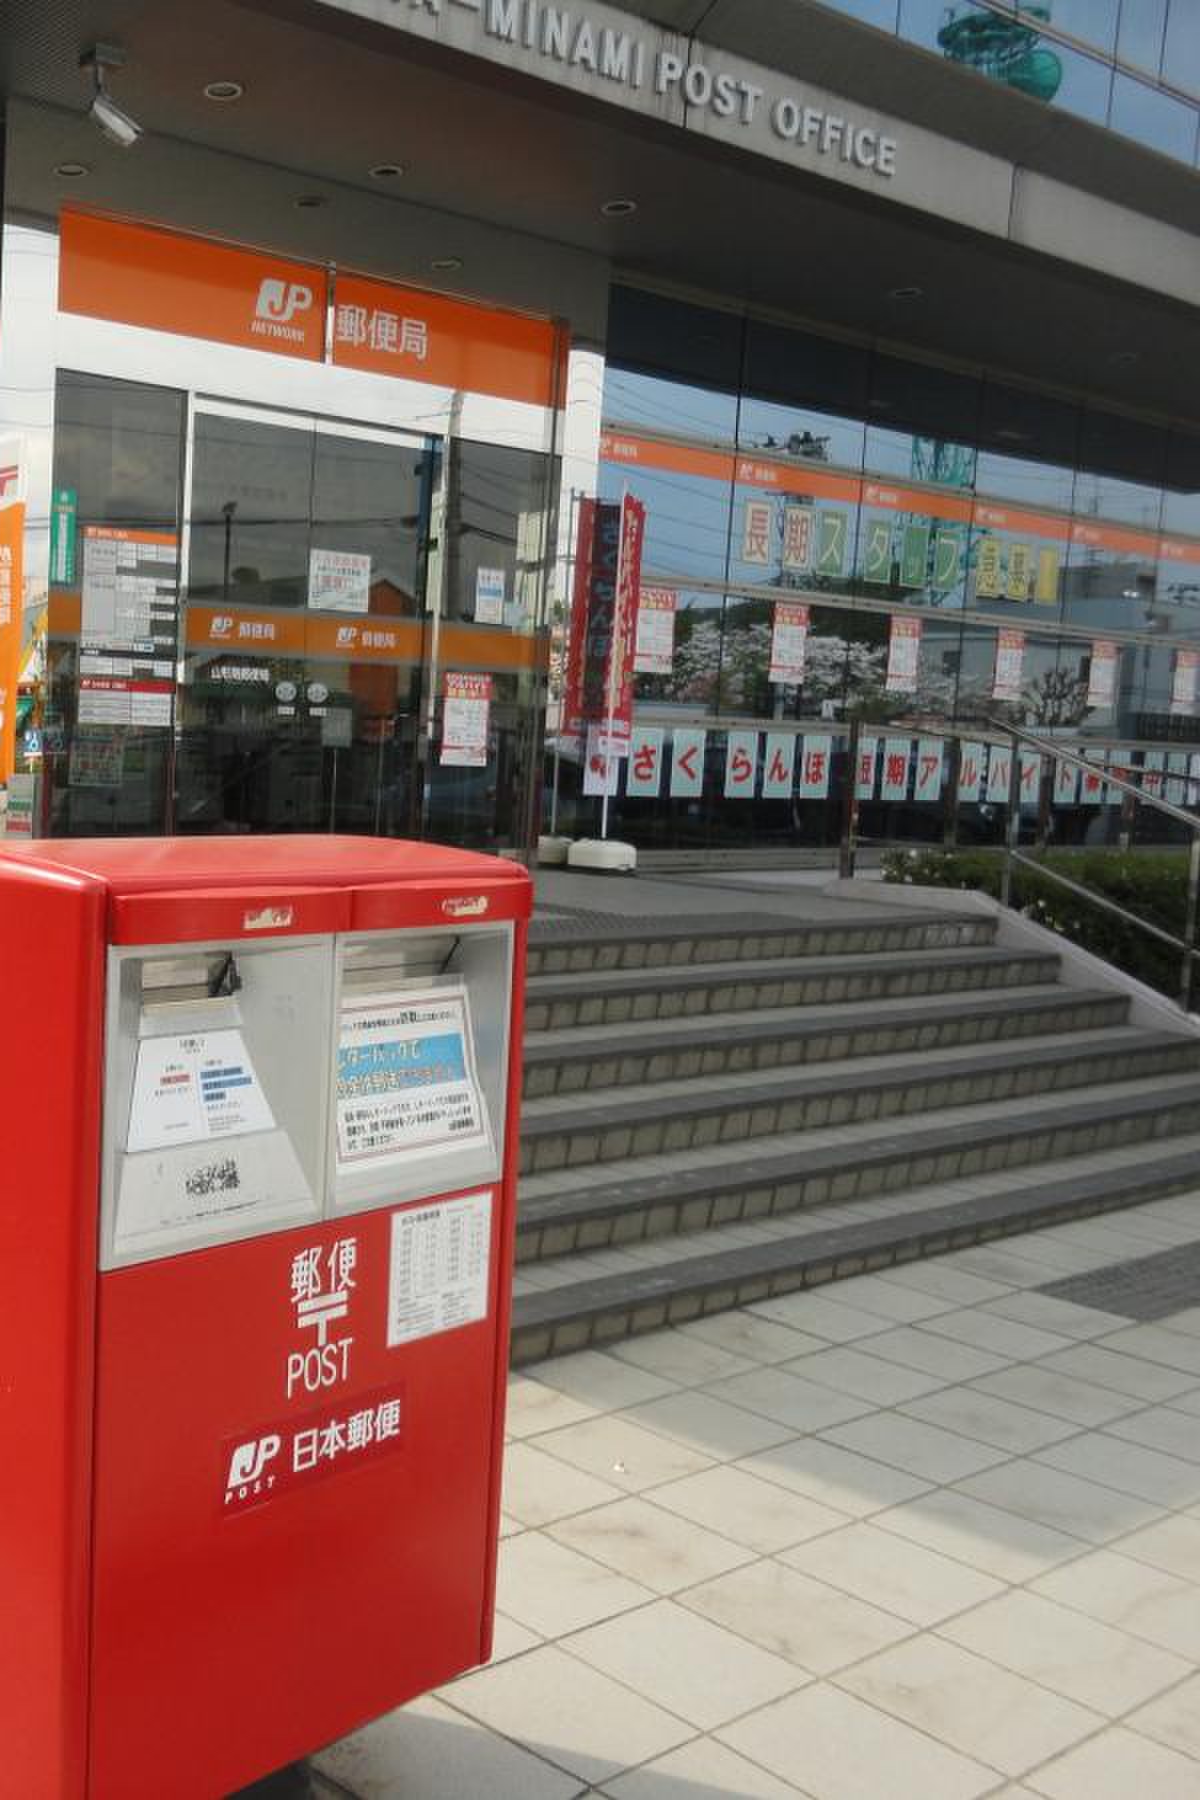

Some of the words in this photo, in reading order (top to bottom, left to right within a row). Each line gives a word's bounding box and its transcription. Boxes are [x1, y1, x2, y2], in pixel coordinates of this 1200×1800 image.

[656, 52, 762, 125] POST
[771, 98, 898, 176] OFFICE
[336, 304, 429, 360] 郵便局
[632, 744, 827, 785] さくらんぼ
[290, 1237, 357, 1304] 郵便
[286, 1336, 354, 1400] POST
[226, 1434, 281, 1489] JP
[293, 1399, 401, 1473] 日本郵便
[224, 1476, 276, 1504] POST
